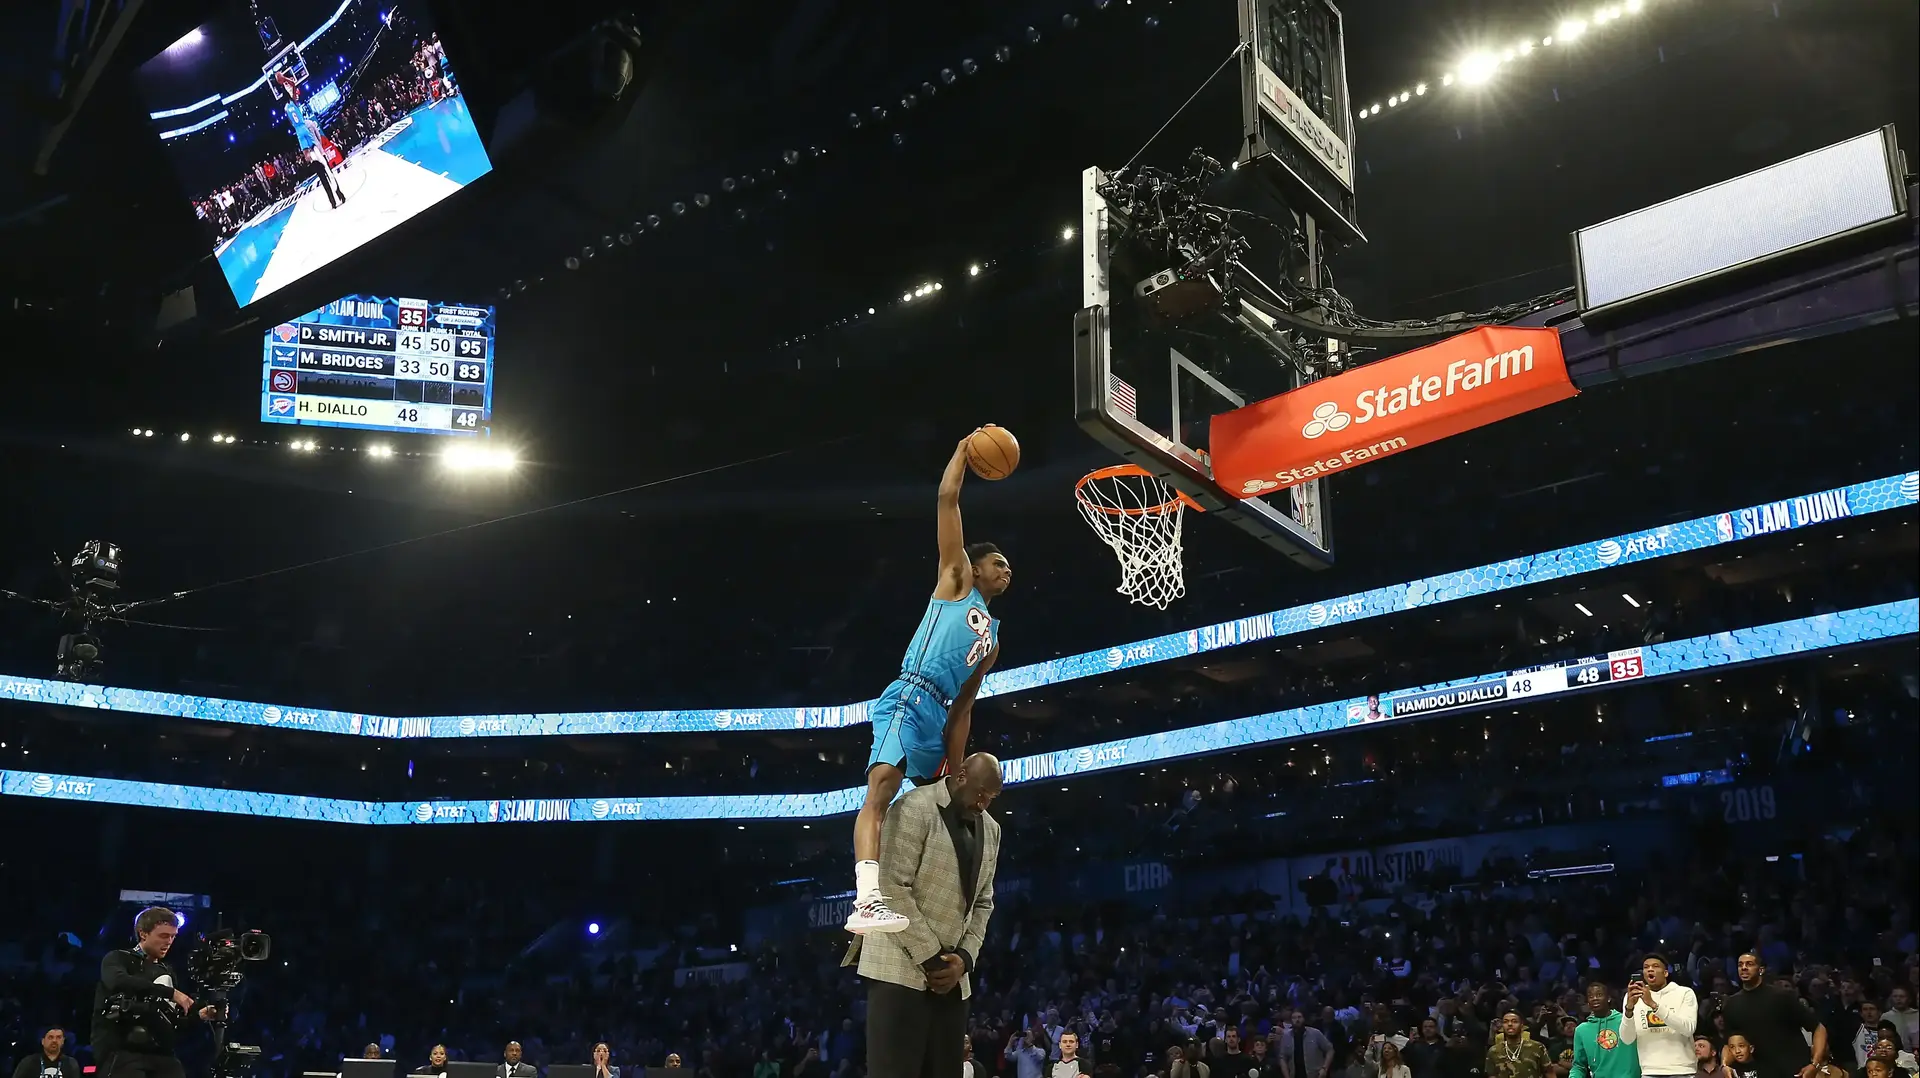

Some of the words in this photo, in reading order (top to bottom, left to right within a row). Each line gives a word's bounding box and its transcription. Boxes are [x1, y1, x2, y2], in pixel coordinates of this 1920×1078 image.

[1286, 99, 1346, 170] TISSOT
[329, 300, 355, 317] SLAM
[357, 301, 385, 319] DUNK
[401, 309, 423, 325] 35
[457, 309, 480, 317] ROUND
[301, 327, 315, 340] D.
[318, 329, 365, 344] SMITH
[368, 332, 391, 346] JR.
[401, 336, 422, 350] 45
[430, 338, 451, 353] 50
[460, 341, 481, 355] 95
[300, 351, 318, 365] M.
[321, 353, 384, 370] BRIDGES
[400, 360, 421, 374] 33
[429, 362, 449, 377] 50
[459, 364, 480, 379] 83
[299, 401, 313, 412] H.
[317, 402, 368, 416] DIALLO
[398, 409, 418, 422] 48
[456, 412, 477, 427] 48
[1740, 500, 1792, 537] SLAM
[1795, 489, 1851, 525] DUNK
[1625, 533, 1669, 556] AT&T
[104, 561, 118, 570] AT&T
[1330, 599, 1365, 618] AT&T
[1203, 621, 1237, 650] SLAM
[1239, 614, 1276, 643] DUNK
[1126, 644, 1157, 663] AT&T
[1577, 655, 1598, 665] TOTAL
[1577, 667, 1600, 684] 48
[1612, 658, 1640, 679] 35
[4, 681, 43, 696] AT&T
[1512, 679, 1532, 694] 48
[1396, 693, 1456, 715] HAMIDOU
[1458, 685, 1504, 706] DIALLO
[284, 710, 318, 725] AT&T
[734, 713, 764, 726] AT&T
[810, 706, 841, 728] SLAM
[844, 702, 869, 724] DUNK
[367, 715, 399, 737] SLAM
[401, 717, 433, 738] DUNK
[478, 719, 508, 731] AT&T
[1096, 746, 1128, 762] AT&T
[1001, 760, 1021, 783] LAM
[1025, 754, 1057, 780] DUNK
[56, 780, 96, 795] AT&T
[435, 806, 467, 818] AT&T
[503, 801, 535, 822] SLAM
[536, 800, 570, 821] DUNK
[611, 802, 643, 815] AT&T
[1721, 785, 1777, 824] 2019
